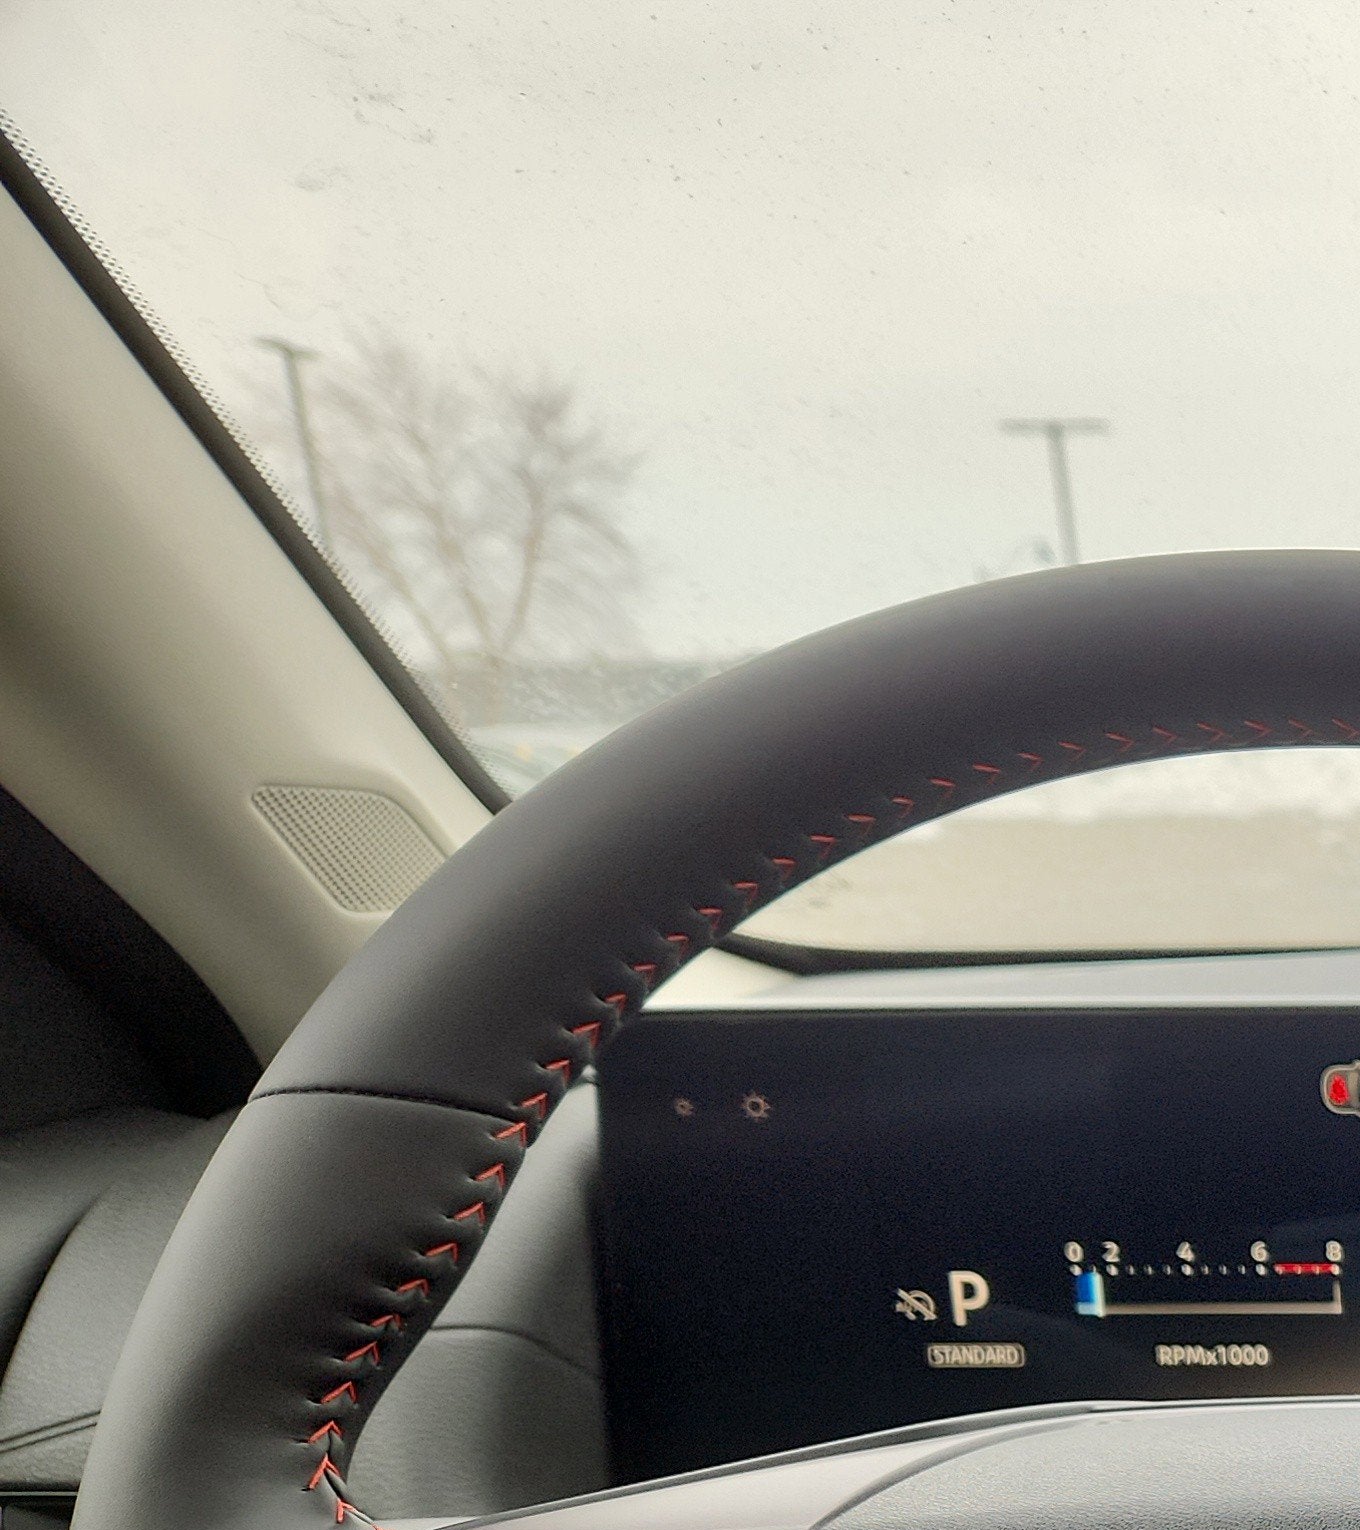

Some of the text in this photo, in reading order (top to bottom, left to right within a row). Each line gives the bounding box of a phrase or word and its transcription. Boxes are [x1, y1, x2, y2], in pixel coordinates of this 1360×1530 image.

[1064, 1241, 1084, 1262] 0
[1102, 1241, 1121, 1262] 2
[1176, 1241, 1195, 1262] 4
[1250, 1241, 1269, 1262] 6
[1325, 1240, 1344, 1262] 8
[948, 1271, 990, 1327] P
[931, 1346, 1020, 1364] STANDARD
[1156, 1344, 1270, 1366] RPMx1000
